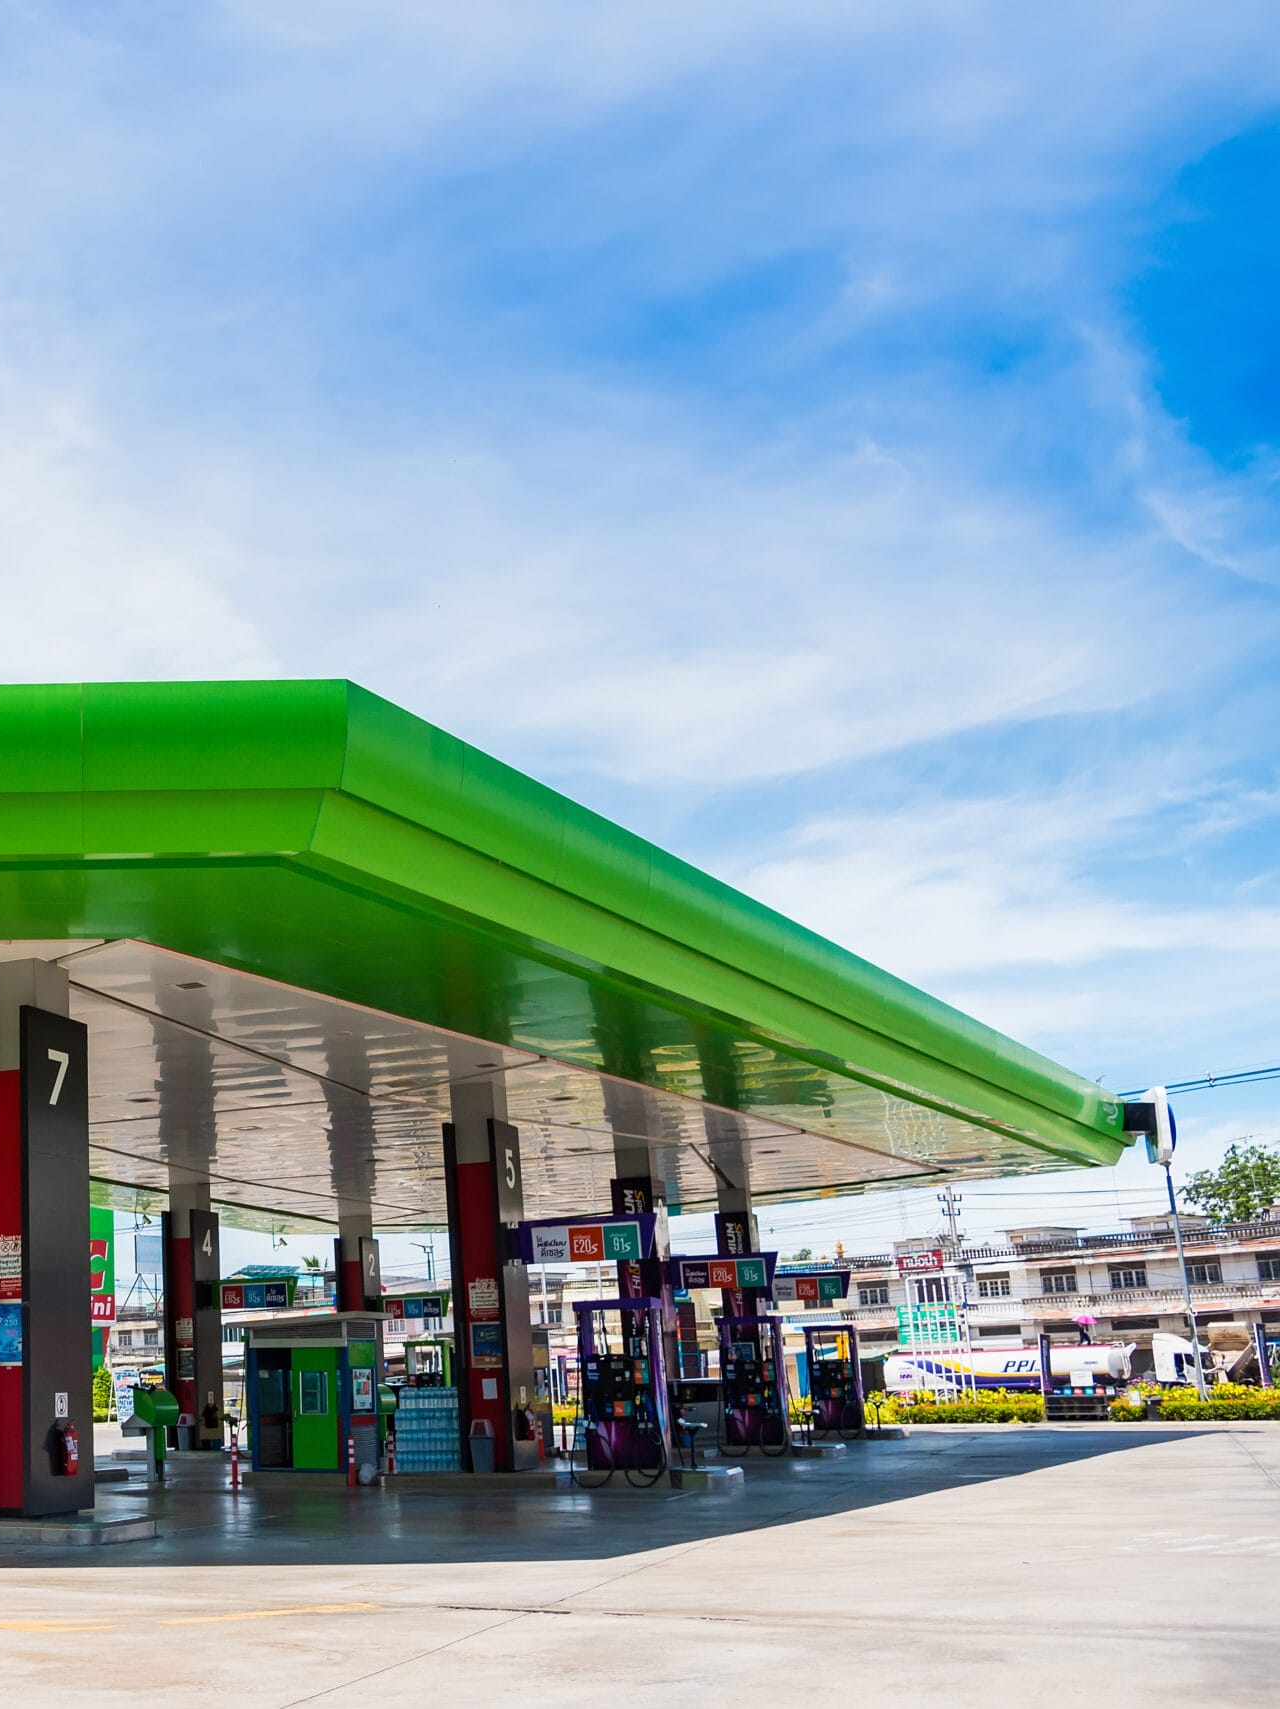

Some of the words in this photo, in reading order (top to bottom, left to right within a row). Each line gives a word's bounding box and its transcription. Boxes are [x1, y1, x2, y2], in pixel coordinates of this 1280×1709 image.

[48, 1048, 69, 1106] 7
[505, 1148, 516, 1190] 5
[202, 1229, 212, 1257] 4
[368, 1253, 376, 1277] 2
